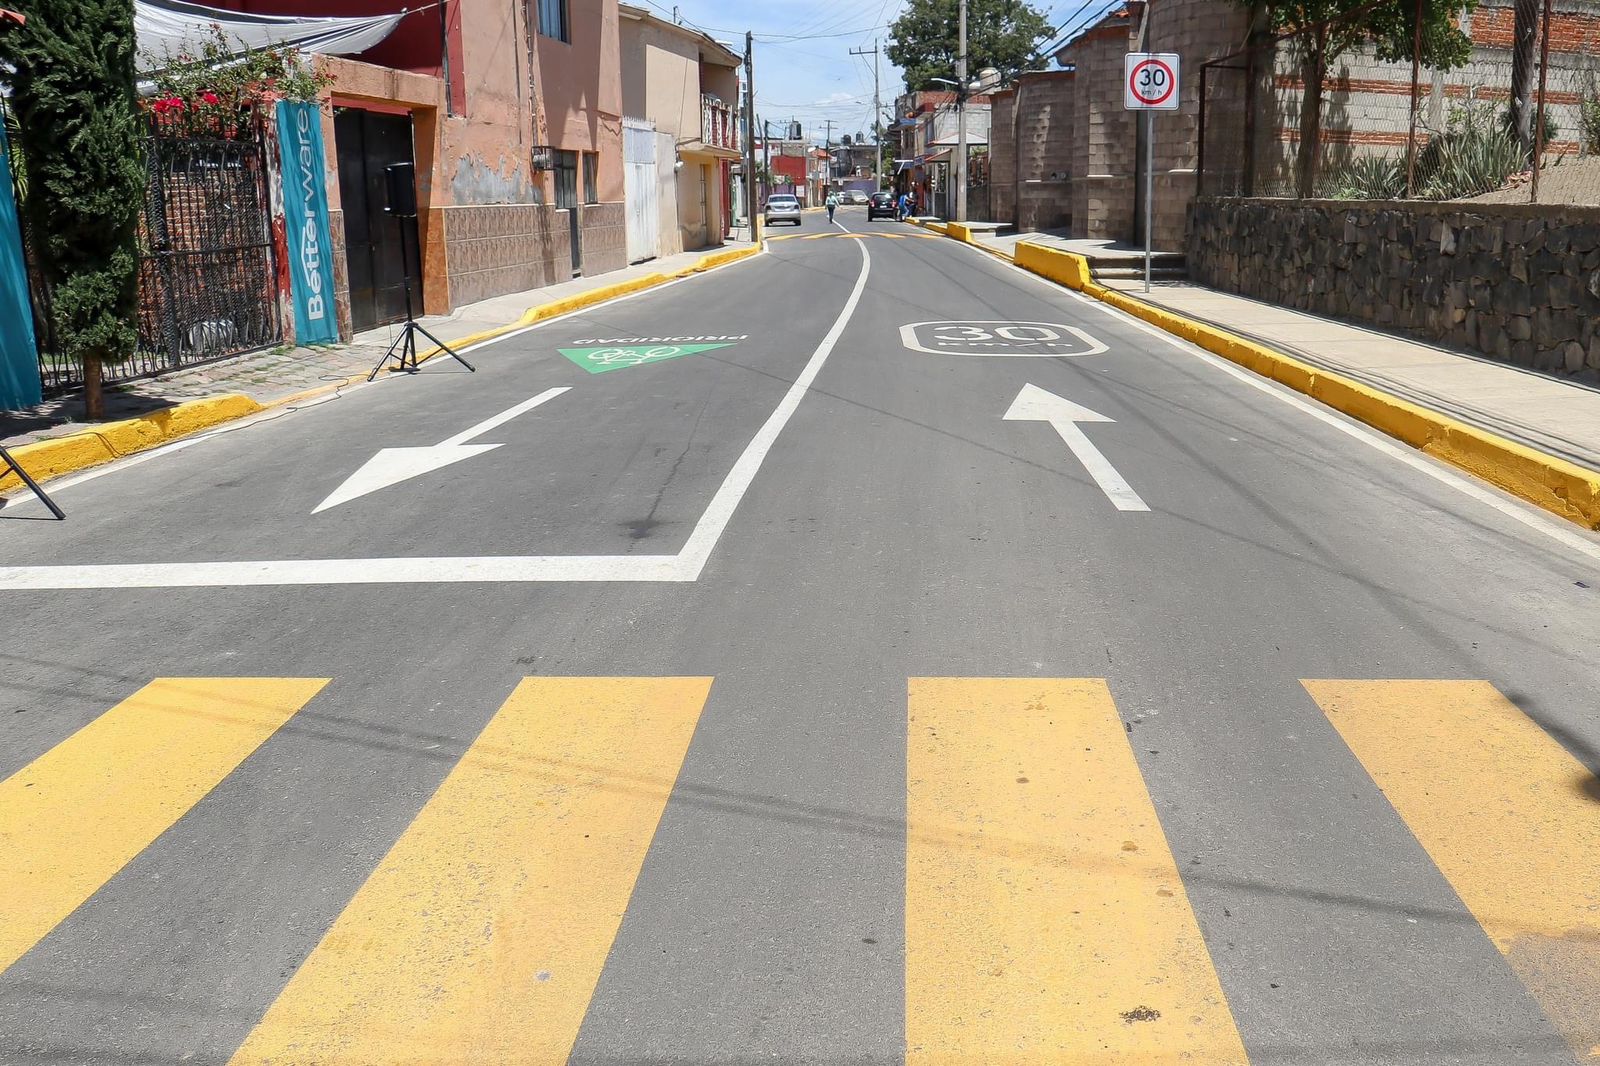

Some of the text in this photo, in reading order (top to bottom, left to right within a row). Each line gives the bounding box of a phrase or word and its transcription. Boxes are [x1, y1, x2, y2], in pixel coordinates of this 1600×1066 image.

[1140, 69, 1165, 86] 30
[297, 108, 324, 321] Betterware
[572, 335, 749, 345] PRIORIDAD
[934, 326, 1061, 340] 30
